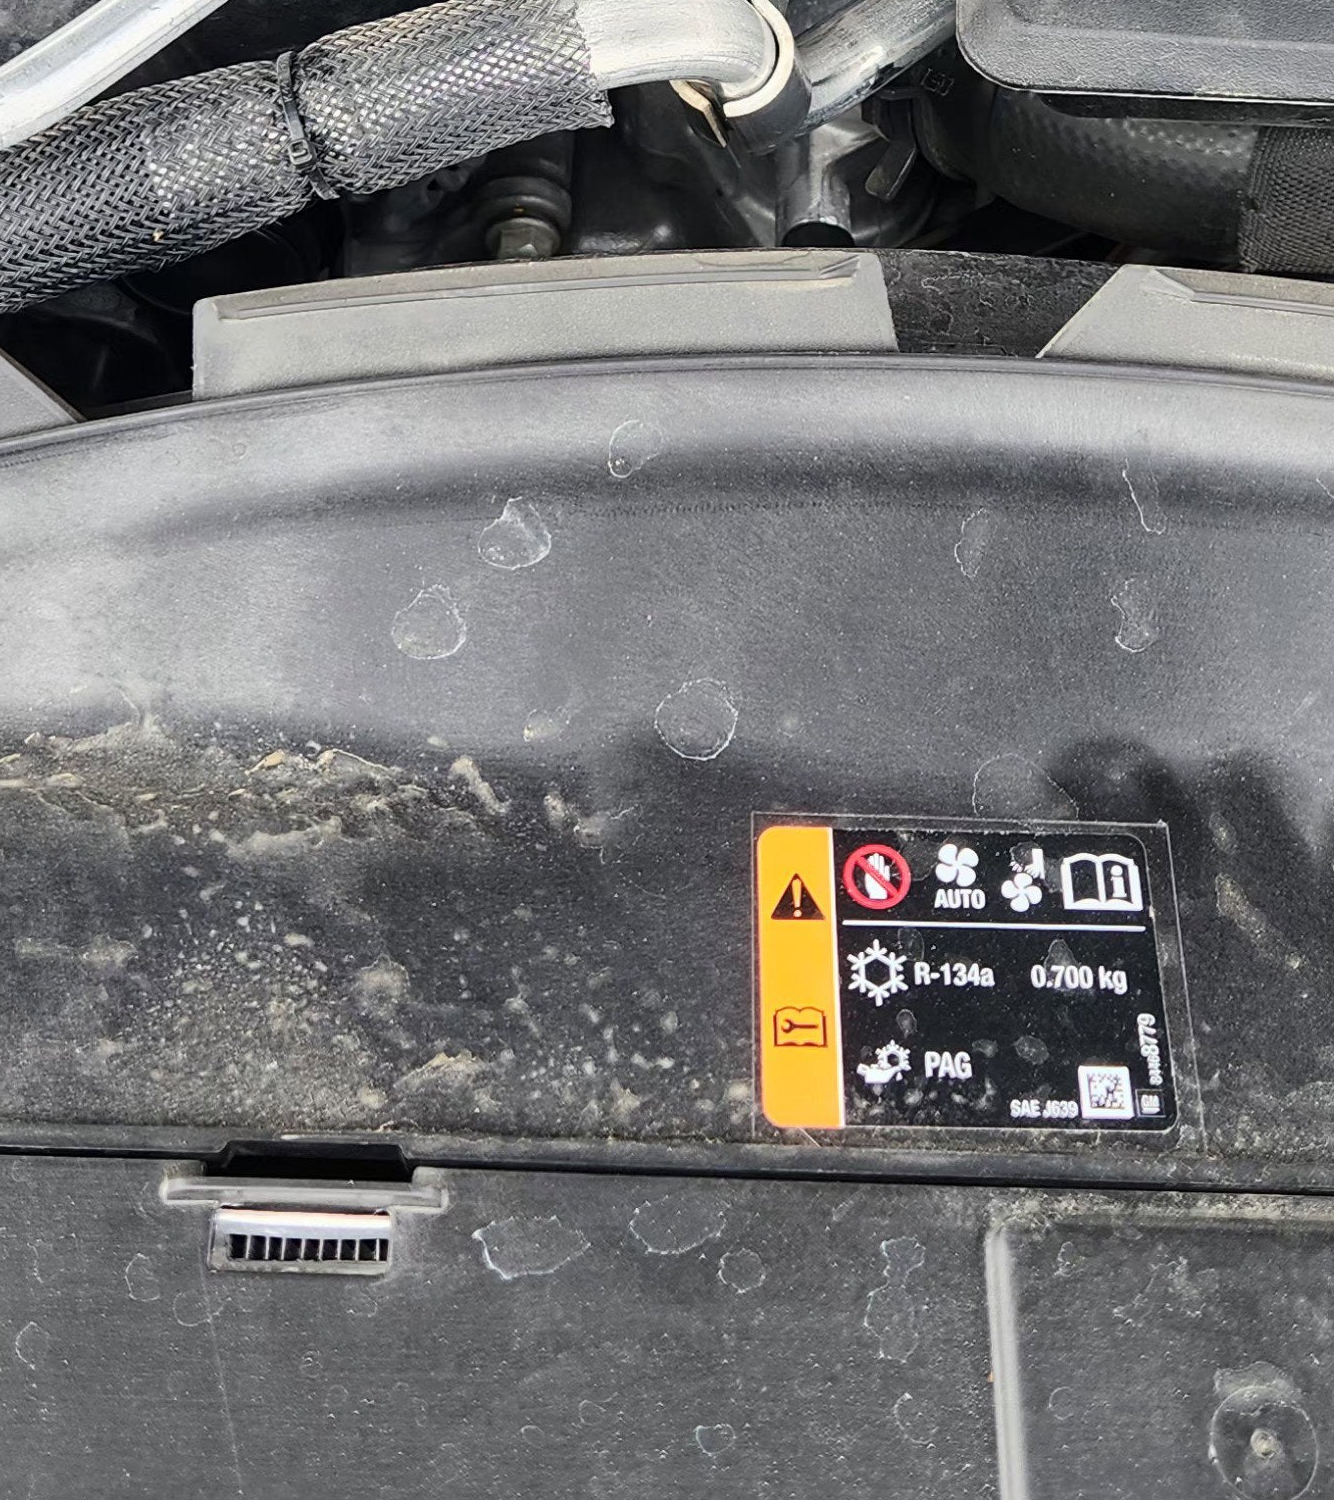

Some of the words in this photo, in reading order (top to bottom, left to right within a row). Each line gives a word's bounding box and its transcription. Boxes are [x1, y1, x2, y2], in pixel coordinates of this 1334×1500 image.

[934, 889, 985, 910] AUTO
[914, 963, 995, 989] R-134a
[1030, 965, 1094, 990] 0.700
[1098, 965, 1128, 995] kg
[924, 1051, 972, 1078] PAG
[1009, 1098, 1041, 1118] SAE
[1042, 1099, 1079, 1119] J639
[1141, 1094, 1161, 1114] GM
